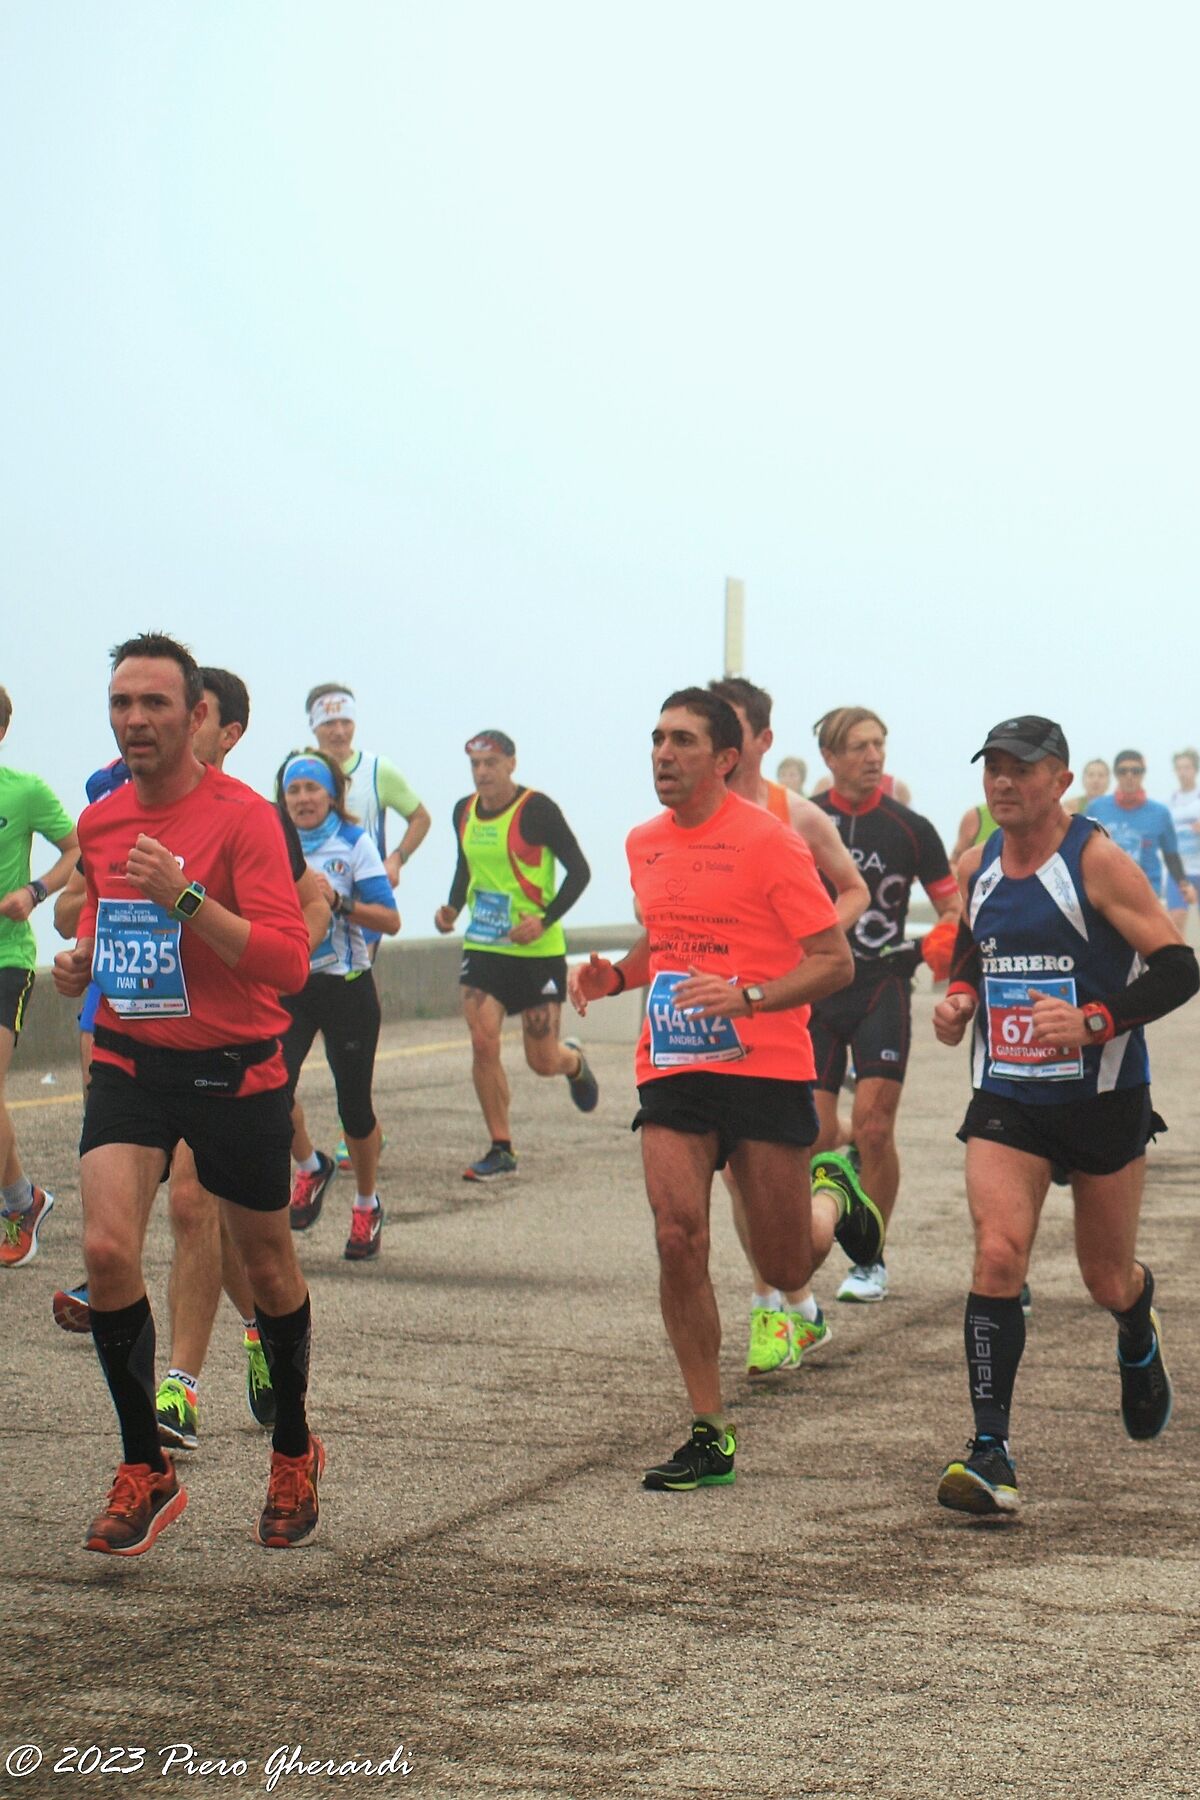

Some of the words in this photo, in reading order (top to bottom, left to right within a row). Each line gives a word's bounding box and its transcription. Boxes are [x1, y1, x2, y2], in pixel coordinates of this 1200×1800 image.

[97, 938, 177, 975] H3235
[117, 976, 137, 990] IVAN
[669, 1034, 705, 1046] ANDREA
[996, 1045, 1058, 1058] GIANFRANCO
